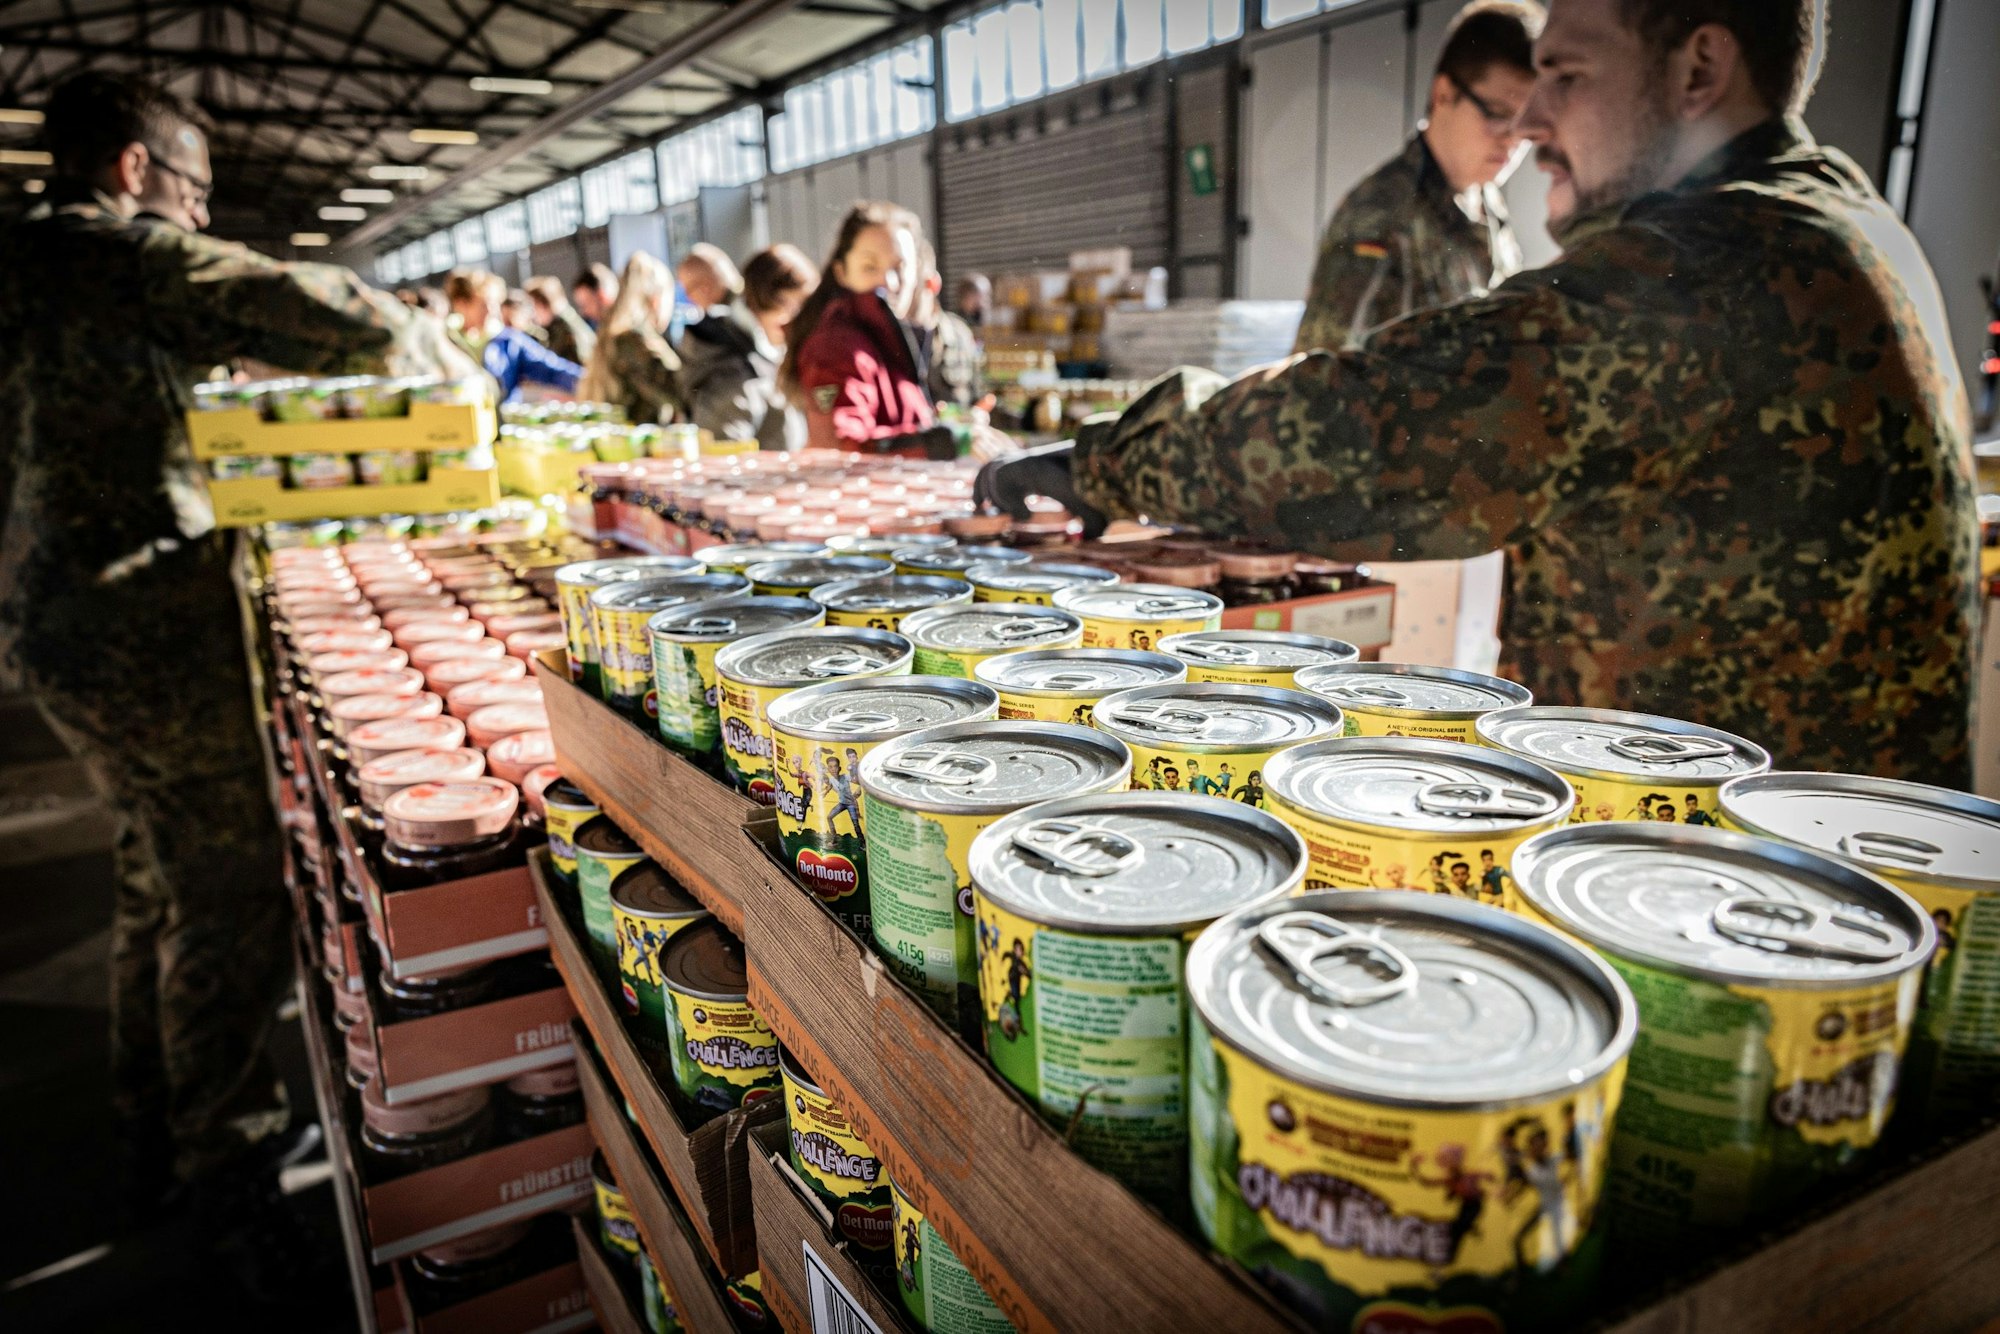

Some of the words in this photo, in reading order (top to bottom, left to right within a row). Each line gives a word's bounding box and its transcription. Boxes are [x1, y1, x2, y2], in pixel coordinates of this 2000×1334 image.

[1393, 724, 1417, 732] NETFLIX
[1418, 725, 1446, 733] ORIGINAL
[799, 859, 815, 875] Del
[815, 864, 855, 884] Monte
[811, 879, 838, 892] Quality
[897, 939, 924, 966] 415g
[899, 960, 927, 988] 250g
[686, 1039, 777, 1069] CHALLENGE
[758, 988, 781, 1030] JUICE
[787, 1028, 800, 1056] AU
[802, 1051, 821, 1079] JUS
[829, 1079, 846, 1108] OP
[849, 1101, 870, 1136] SAP
[881, 1140, 896, 1175] IN
[899, 1163, 930, 1213] SAFT
[791, 1130, 875, 1181] CHALLENGE
[841, 1213, 862, 1230] Del
[863, 1217, 893, 1231] Mon
